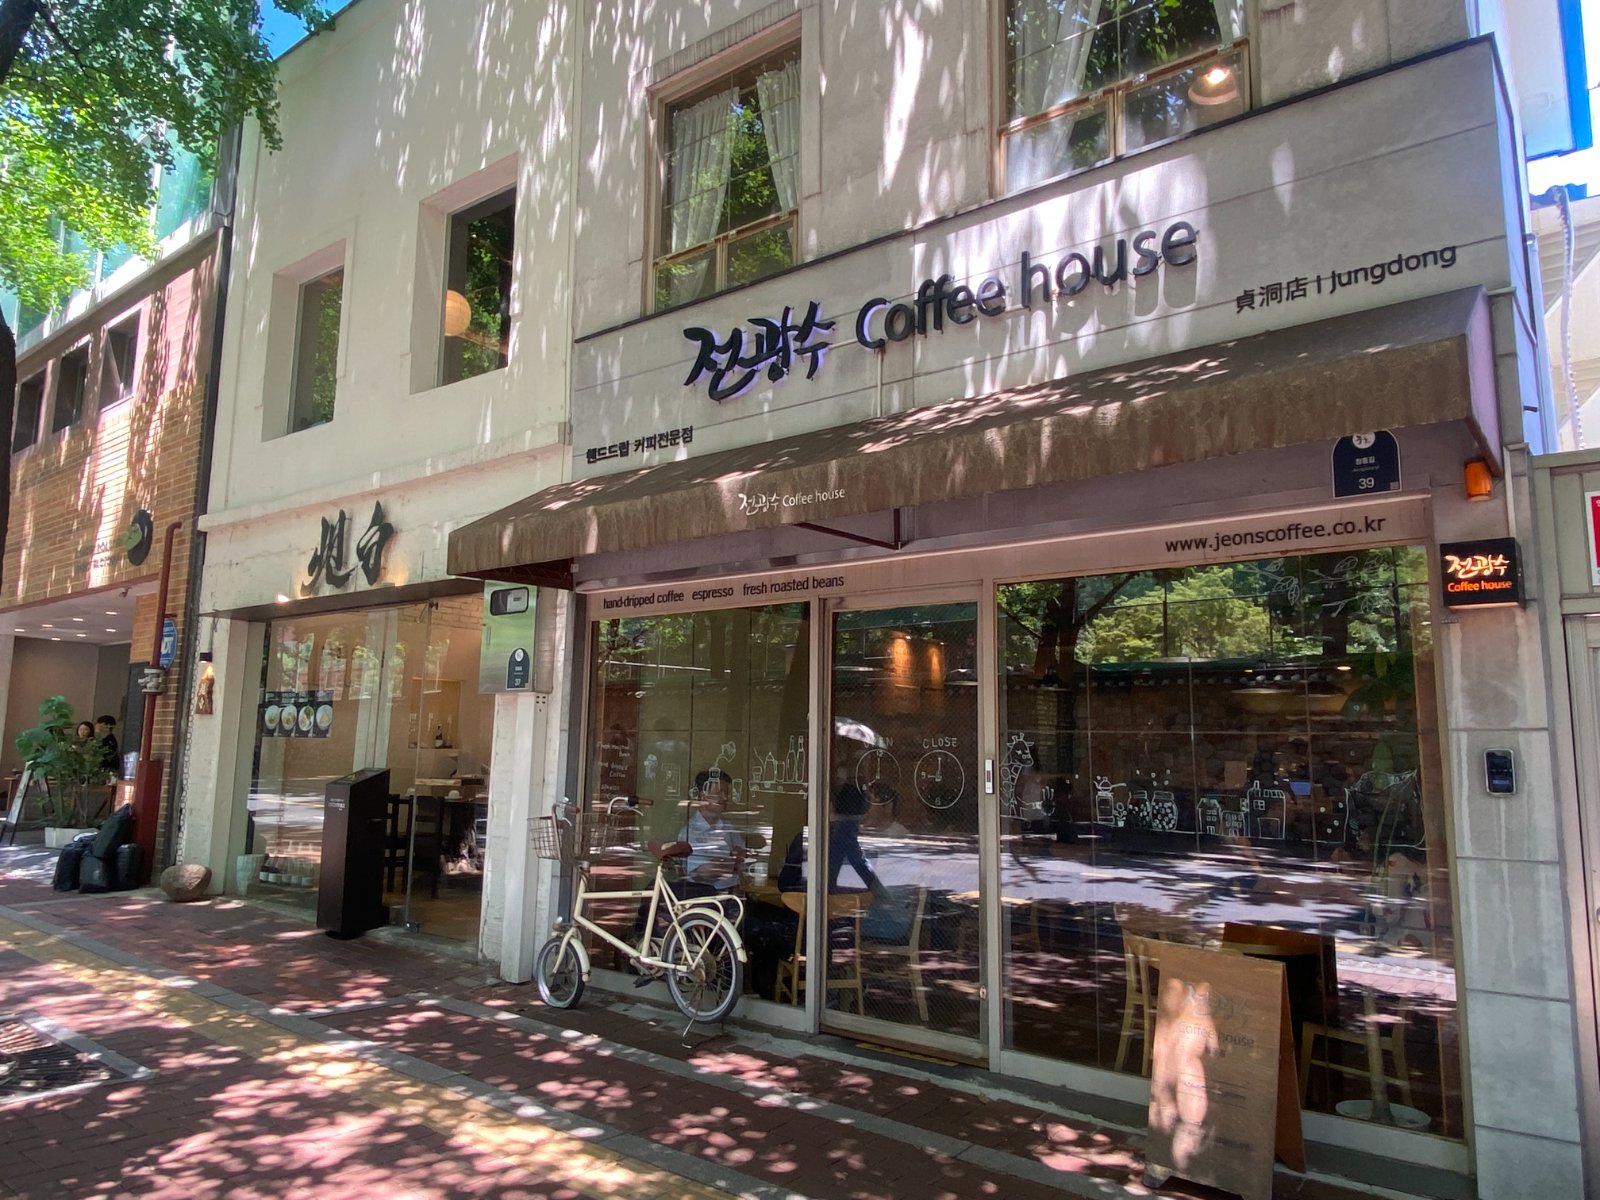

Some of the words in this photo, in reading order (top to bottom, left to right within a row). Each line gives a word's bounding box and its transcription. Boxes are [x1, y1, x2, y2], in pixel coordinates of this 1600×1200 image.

[1236, 277, 1308, 314] 貞洞店
[683, 301, 836, 402] 전광수
[856, 274, 1006, 349] Coffee
[1021, 221, 1199, 308] house
[634, 425, 693, 453] 커피전문점
[1358, 477, 1375, 490] 39
[738, 491, 780, 515] 전광수
[782, 493, 813, 507] Coffee
[815, 488, 845, 503] house
[1165, 516, 1386, 552] www.jeonscoffee.co.kr
[1445, 554, 1510, 579] 전광수
[603, 592, 655, 609] hand-dripped
[656, 590, 685, 604] coffee
[692, 587, 734, 602] espresso
[743, 582, 767, 596] fresh
[770, 577, 809, 593] roasted
[812, 576, 845, 589] beans
[1448, 581, 1480, 593] Coffee
[1481, 580, 1512, 590] house
[922, 736, 958, 749] CLOSE
